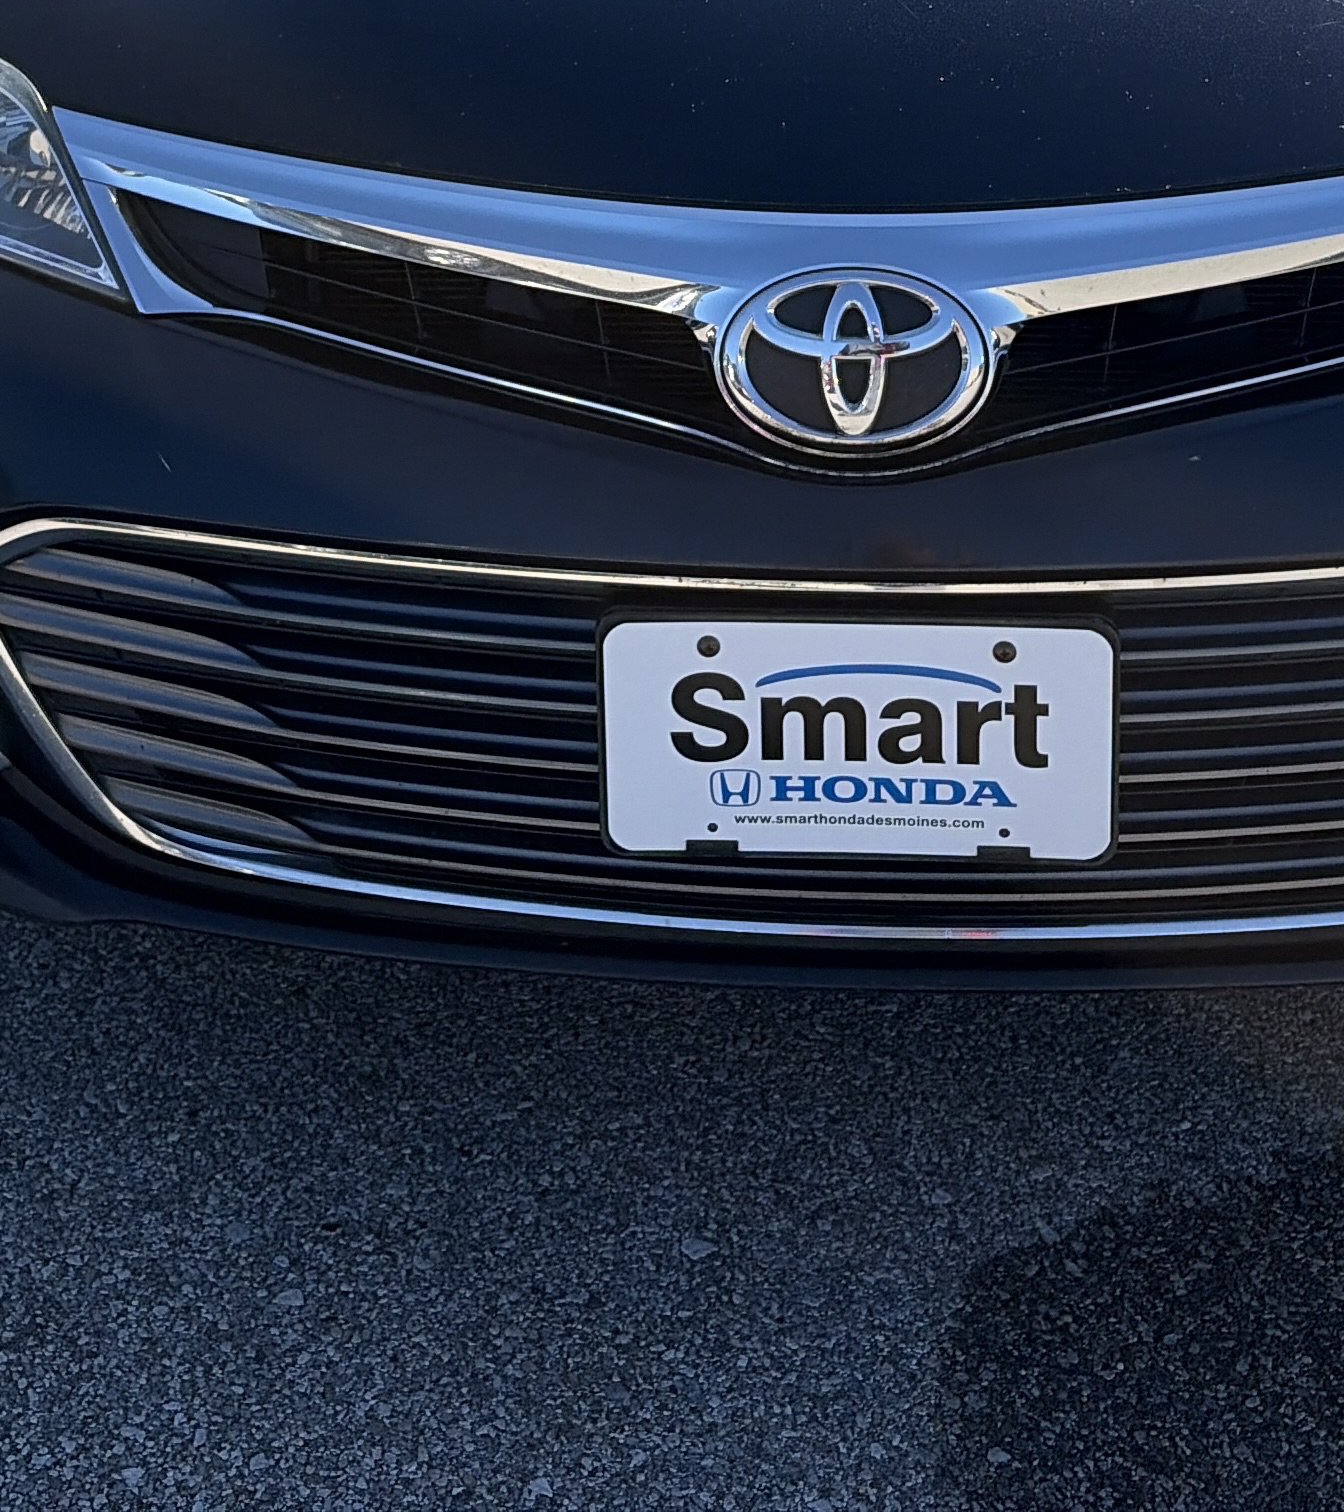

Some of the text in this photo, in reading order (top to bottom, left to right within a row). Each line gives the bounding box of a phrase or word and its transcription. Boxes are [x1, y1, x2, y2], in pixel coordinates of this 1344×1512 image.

[669, 671, 1050, 769] Smart
[769, 775, 1018, 808] HONDA
[733, 813, 986, 830] www.smarthondadesmoines.com
